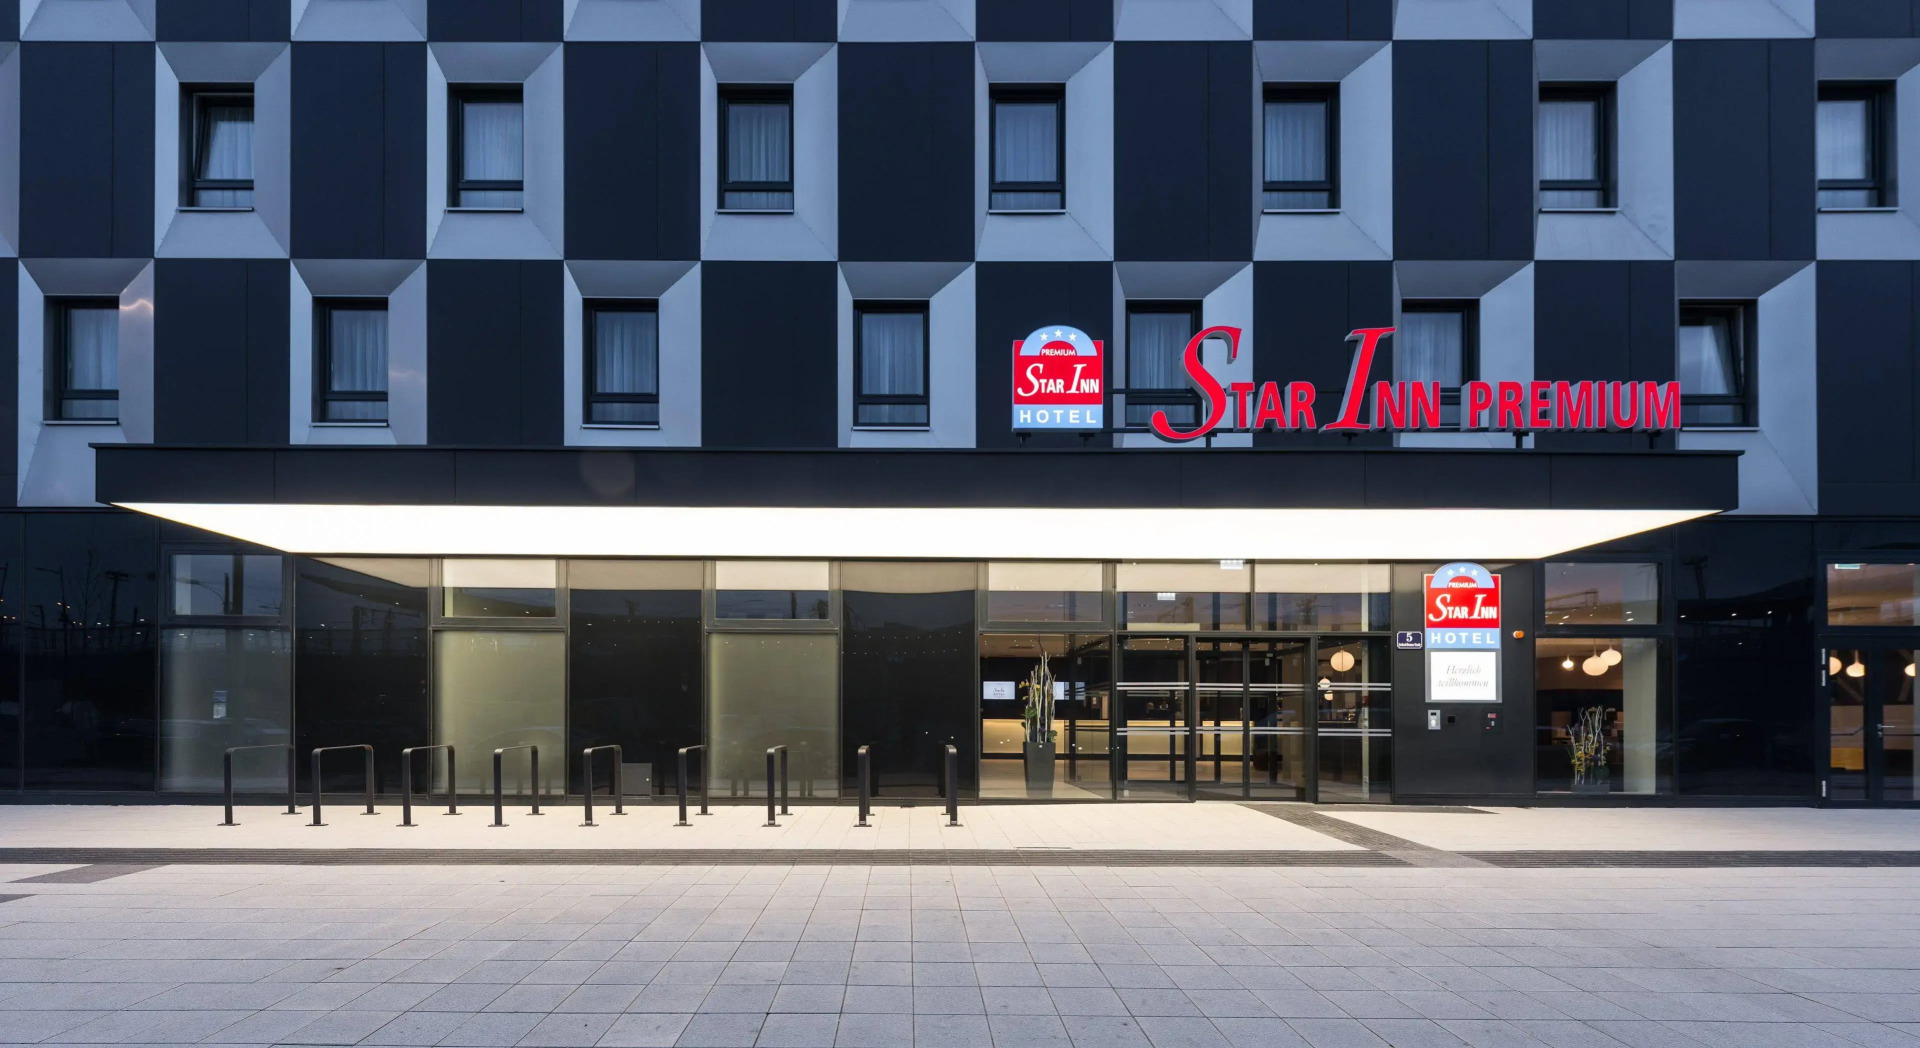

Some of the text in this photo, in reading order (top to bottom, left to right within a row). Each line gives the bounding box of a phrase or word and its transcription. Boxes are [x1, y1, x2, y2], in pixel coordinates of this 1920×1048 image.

[1041, 348, 1076, 356] PREMIUM
[1467, 380, 1681, 429] PREMIUM
[1019, 409, 1097, 424] HOTEL
[1406, 632, 1413, 643] 5
[1430, 632, 1496, 645] HOTEL
